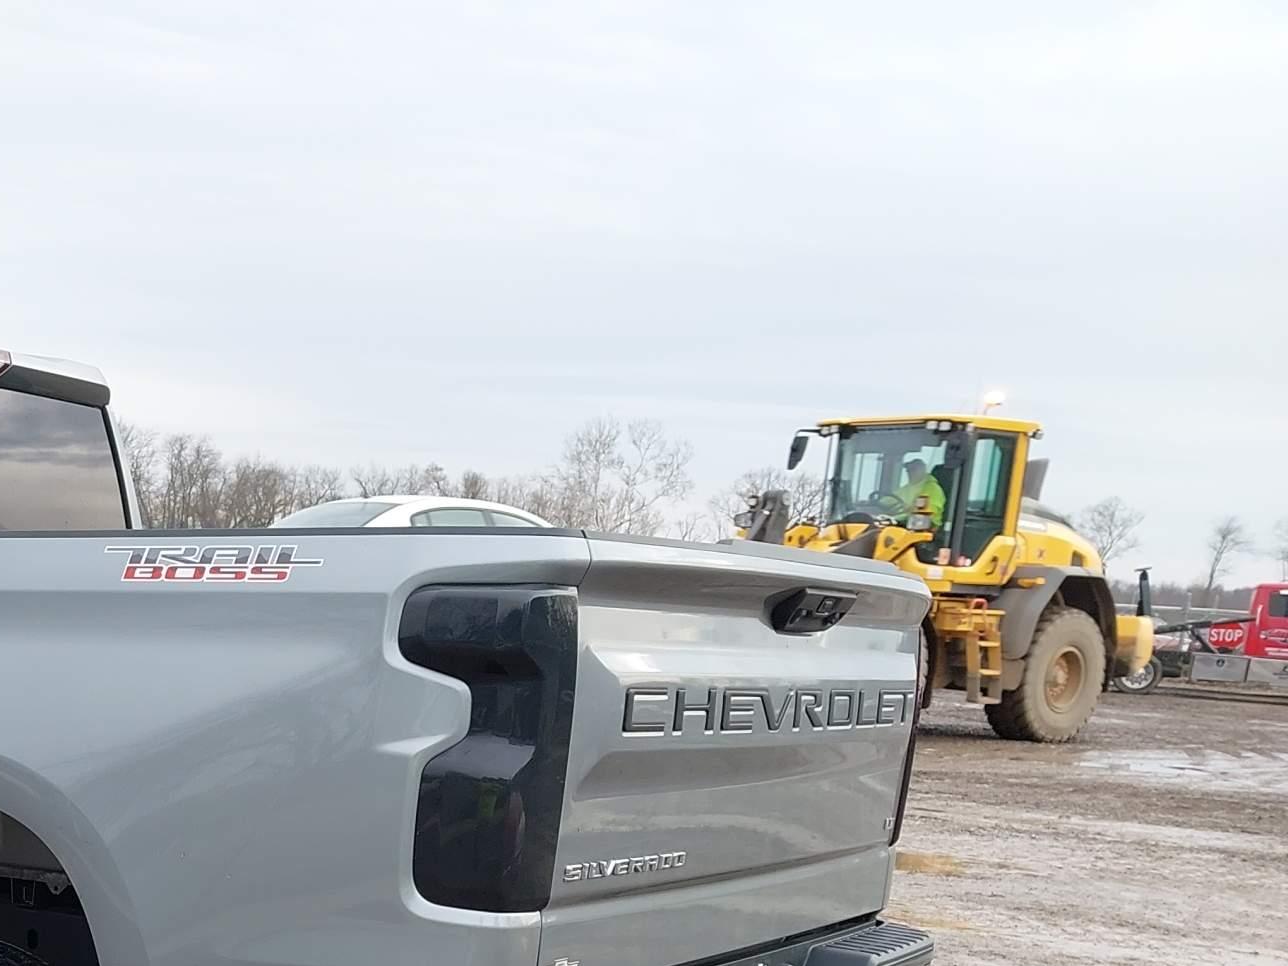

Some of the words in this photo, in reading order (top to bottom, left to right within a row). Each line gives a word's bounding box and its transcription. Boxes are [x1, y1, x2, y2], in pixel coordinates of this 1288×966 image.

[104, 544, 325, 566] TRAIL
[121, 565, 294, 583] BOSS
[1210, 628, 1244, 642] STOP
[622, 687, 915, 738] CHEVROLET
[563, 851, 688, 882] SILVERADO
